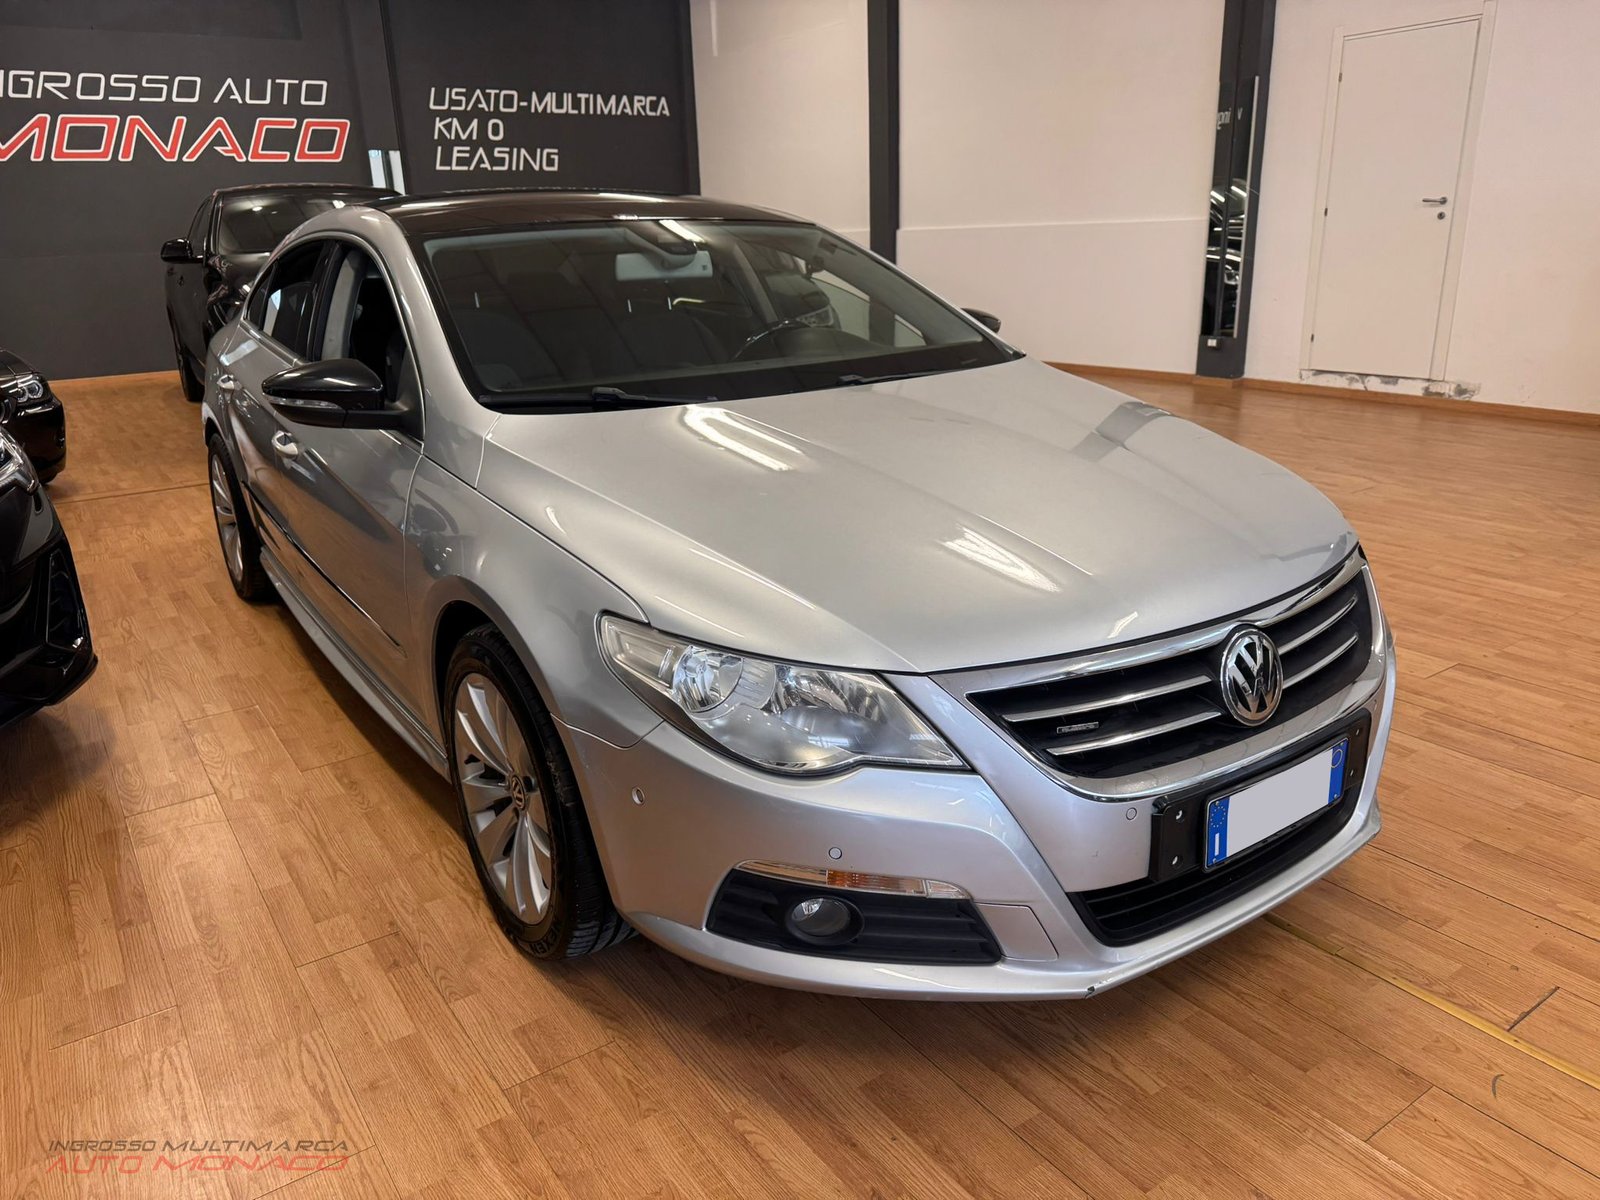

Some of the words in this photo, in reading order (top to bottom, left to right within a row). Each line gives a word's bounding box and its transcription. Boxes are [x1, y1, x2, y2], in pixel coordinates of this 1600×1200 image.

[0, 70, 200, 103] GROSSO
[213, 77, 328, 106] AUTO
[429, 87, 671, 117] USATO-MULTIMARCA
[434, 116, 478, 140] KM
[435, 146, 559, 171] LEASING
